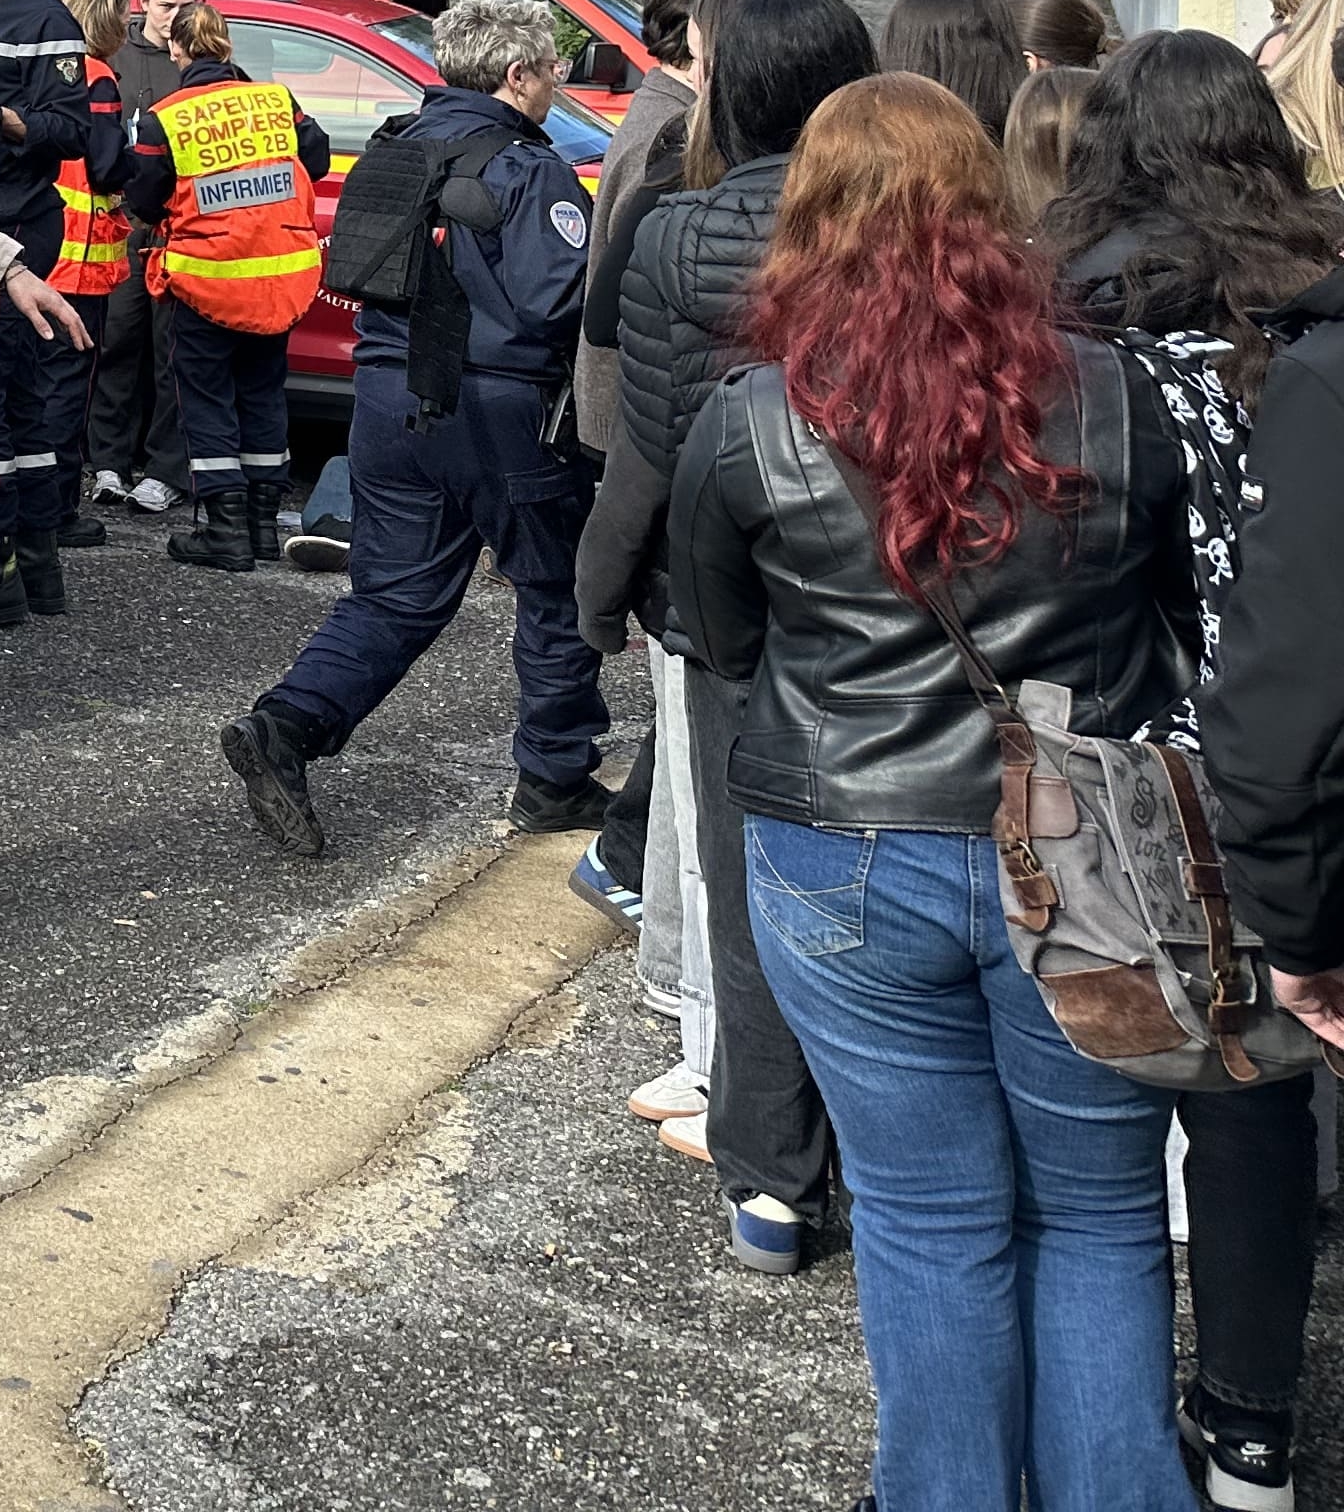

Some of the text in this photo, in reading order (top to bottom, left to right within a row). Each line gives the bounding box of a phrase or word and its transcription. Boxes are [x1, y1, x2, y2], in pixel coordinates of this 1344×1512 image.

[175, 91, 284, 128] SAPEURS
[176, 111, 292, 152] POMPIERS
[199, 133, 289, 168] SDIS 2B
[200, 171, 292, 206] INFIRMIER
